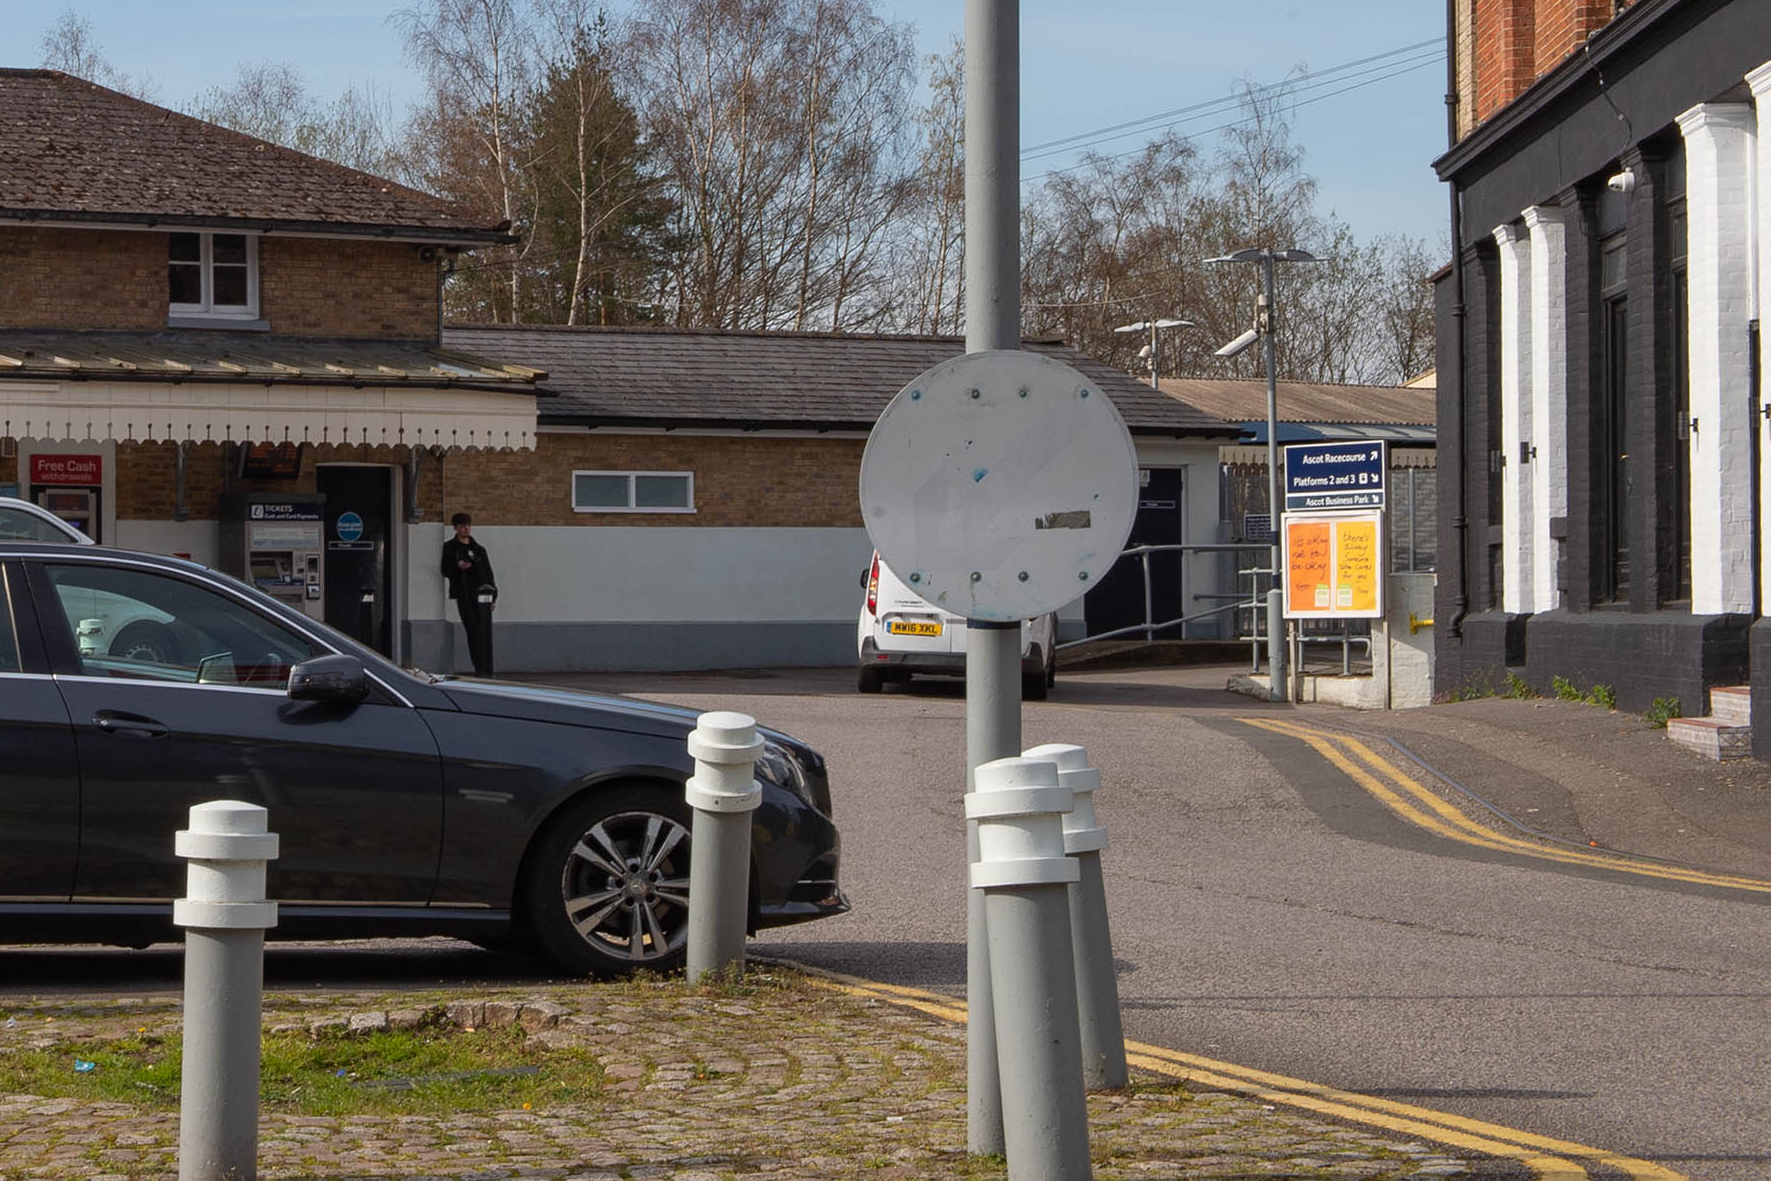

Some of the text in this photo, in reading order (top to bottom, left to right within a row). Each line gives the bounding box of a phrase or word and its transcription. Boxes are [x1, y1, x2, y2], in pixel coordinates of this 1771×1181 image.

[1302, 453, 1366, 465] Ascot Racecourse
[38, 459, 96, 473] Free Cash
[41, 472, 93, 481] withdrawals
[1293, 474, 1356, 487] Platforms 2 and 3
[1306, 494, 1369, 507] Ascot Business Park
